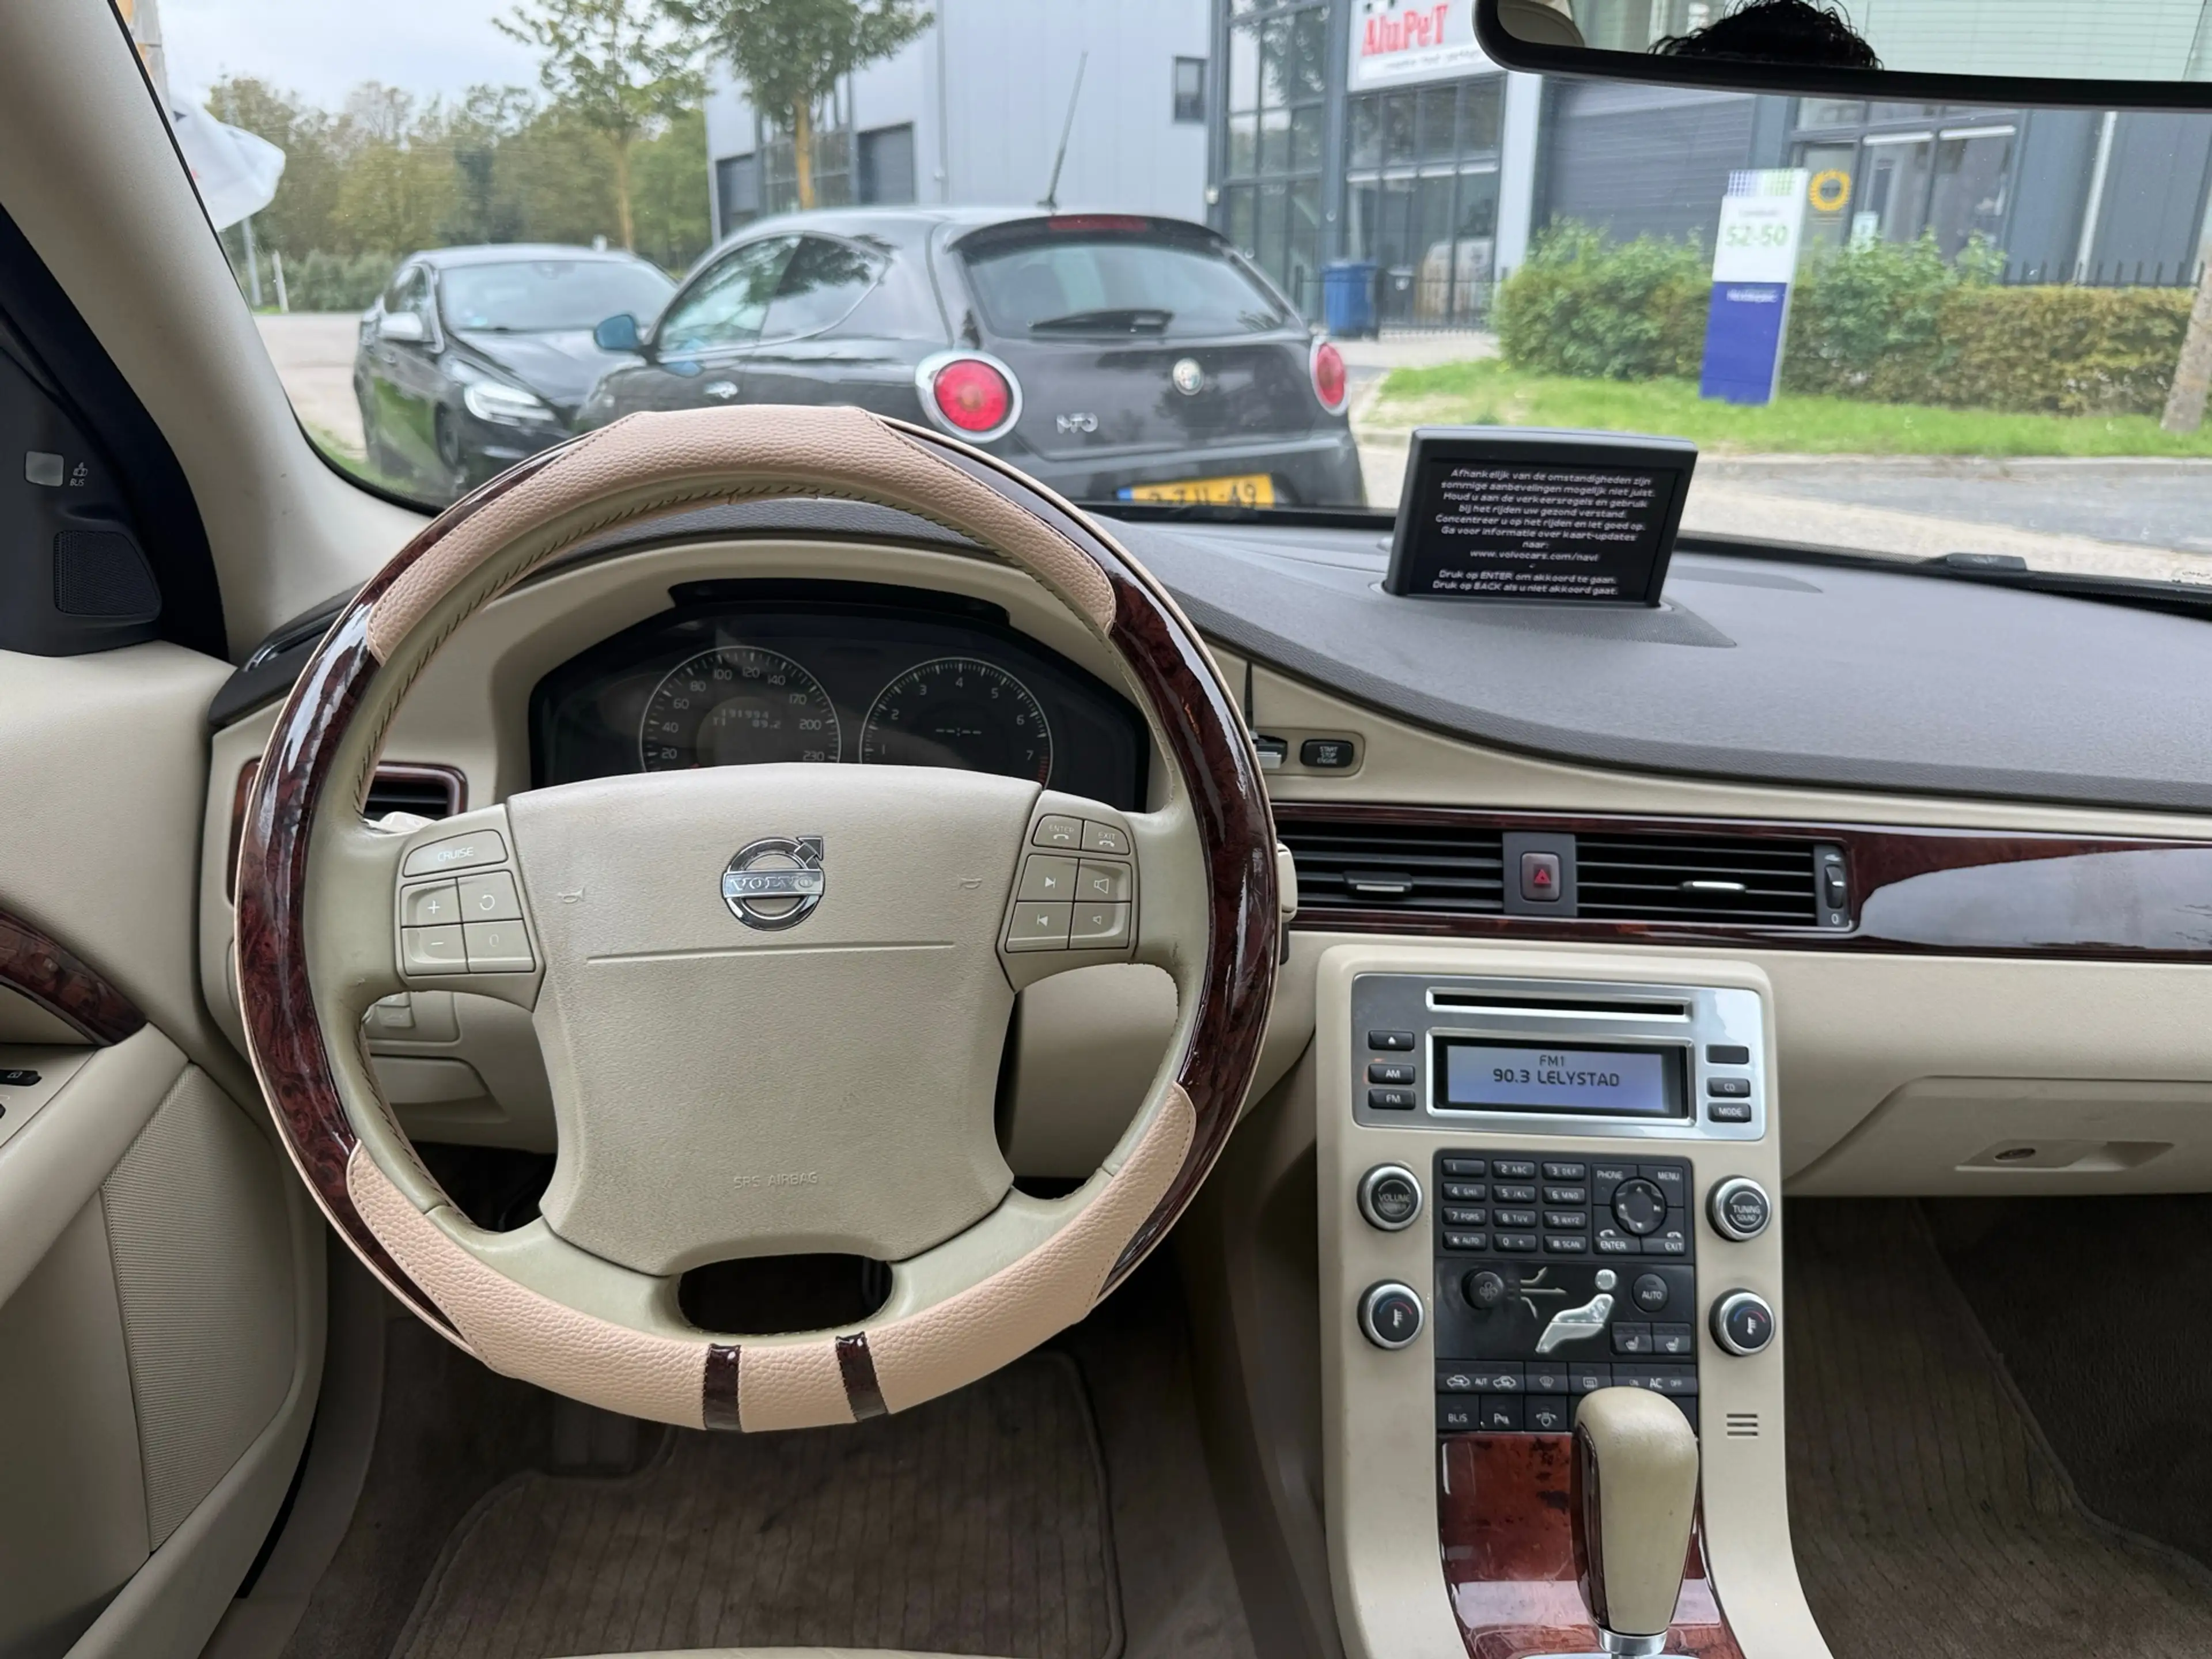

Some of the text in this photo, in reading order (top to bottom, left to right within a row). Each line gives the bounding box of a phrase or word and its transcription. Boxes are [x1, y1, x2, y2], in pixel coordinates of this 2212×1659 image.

[1451, 469, 1509, 480] Afhankelijk
[1533, 472, 1546, 480] de
[1547, 475, 1631, 484] omstandigheden
[1633, 478, 1651, 486] zijn
[1441, 482, 1488, 491] sommige
[1489, 482, 1562, 494] aanbevelingen
[1564, 487, 1607, 496] mogelijk
[1628, 489, 1655, 497] juist.
[1443, 492, 1469, 501] Houd
[1501, 494, 1514, 502] de
[1516, 495, 1594, 506] verkeersregels
[1609, 499, 1648, 508] gebruik
[1473, 505, 1491, 513] het
[1493, 505, 1521, 515] rijden
[1541, 508, 1578, 517] gezond
[1578, 509, 1626, 518] verstand.
[1435, 514, 1500, 524] Concentreer
[1509, 518, 1522, 527] op
[1524, 518, 1541, 526] het
[1543, 520, 1572, 528] rijden
[1588, 520, 1602, 528] let
[1604, 522, 1629, 531] goed
[1630, 523, 1645, 531] op.
[1441, 525, 1455, 535] Ga
[1482, 527, 1536, 537] informatie
[1563, 531, 1638, 541] kaart-updates
[1470, 550, 1600, 562] www.volvocars.com/navi
[1439, 570, 1463, 578] Druk
[1480, 571, 1512, 580] ENTER
[1533, 574, 1575, 582] akkoord
[1433, 580, 1457, 589] Druk
[1459, 582, 1472, 590] op
[1474, 582, 1502, 590] BACK
[1503, 583, 1518, 591] als
[1527, 584, 1547, 592] niet
[1548, 585, 1592, 594] akkoord
[1593, 587, 1618, 596] gaat.
[713, 669, 732, 680] 100
[743, 667, 760, 678] 120
[768, 675, 786, 686] 140
[955, 677, 963, 688] 4
[691, 681, 706, 692] 80
[919, 684, 927, 695] 3
[991, 688, 998, 699] 5
[673, 698, 689, 709] 60
[790, 694, 807, 705] 170
[891, 709, 899, 720] 2
[1017, 714, 1024, 725] 6
[662, 722, 679, 733] 40
[800, 719, 821, 730] 200
[662, 748, 677, 759] 20
[803, 751, 824, 762] 230
[1026, 750, 1034, 760] 7
[1049, 824, 1074, 834] ENTER
[1098, 831, 1115, 840] EXIT
[438, 847, 474, 861] CRUISE
[730, 876, 814, 891] VOLVO
[1539, 1055, 1565, 1067] FM1
[1385, 1069, 1400, 1078] AM
[1493, 1069, 1620, 1087] 90.3 LELYSTAD
[1724, 1083, 1735, 1092] CD
[1386, 1094, 1401, 1103] FM
[1718, 1107, 1743, 1116] MODE
[1501, 1164, 1527, 1173] 2 ABC
[1551, 1166, 1557, 1175] 3
[768, 1172, 818, 1187] AIRBAG
[1597, 1170, 1623, 1180] PHONE
[1657, 1171, 1679, 1180] MENU
[1452, 1187, 1458, 1195] 4
[1502, 1187, 1527, 1198] 5 JKL
[1551, 1190, 1578, 1199] 6 MNO
[1452, 1211, 1458, 1219] 7
[1733, 1205, 1761, 1214] TUNING
[1502, 1213, 1528, 1223] 8 TUV
[1552, 1215, 1579, 1224] 9 WXYZ
[1462, 1236, 1479, 1244] AUTO
[1502, 1237, 1509, 1246] 0
[1600, 1240, 1626, 1250] ENTER
[1665, 1241, 1682, 1251] EXIT
[1642, 1291, 1662, 1300] AUTO
[1475, 1377, 1488, 1386] AUT
[1649, 1378, 1662, 1388] AC
[1448, 1413, 1468, 1422] BLIS
